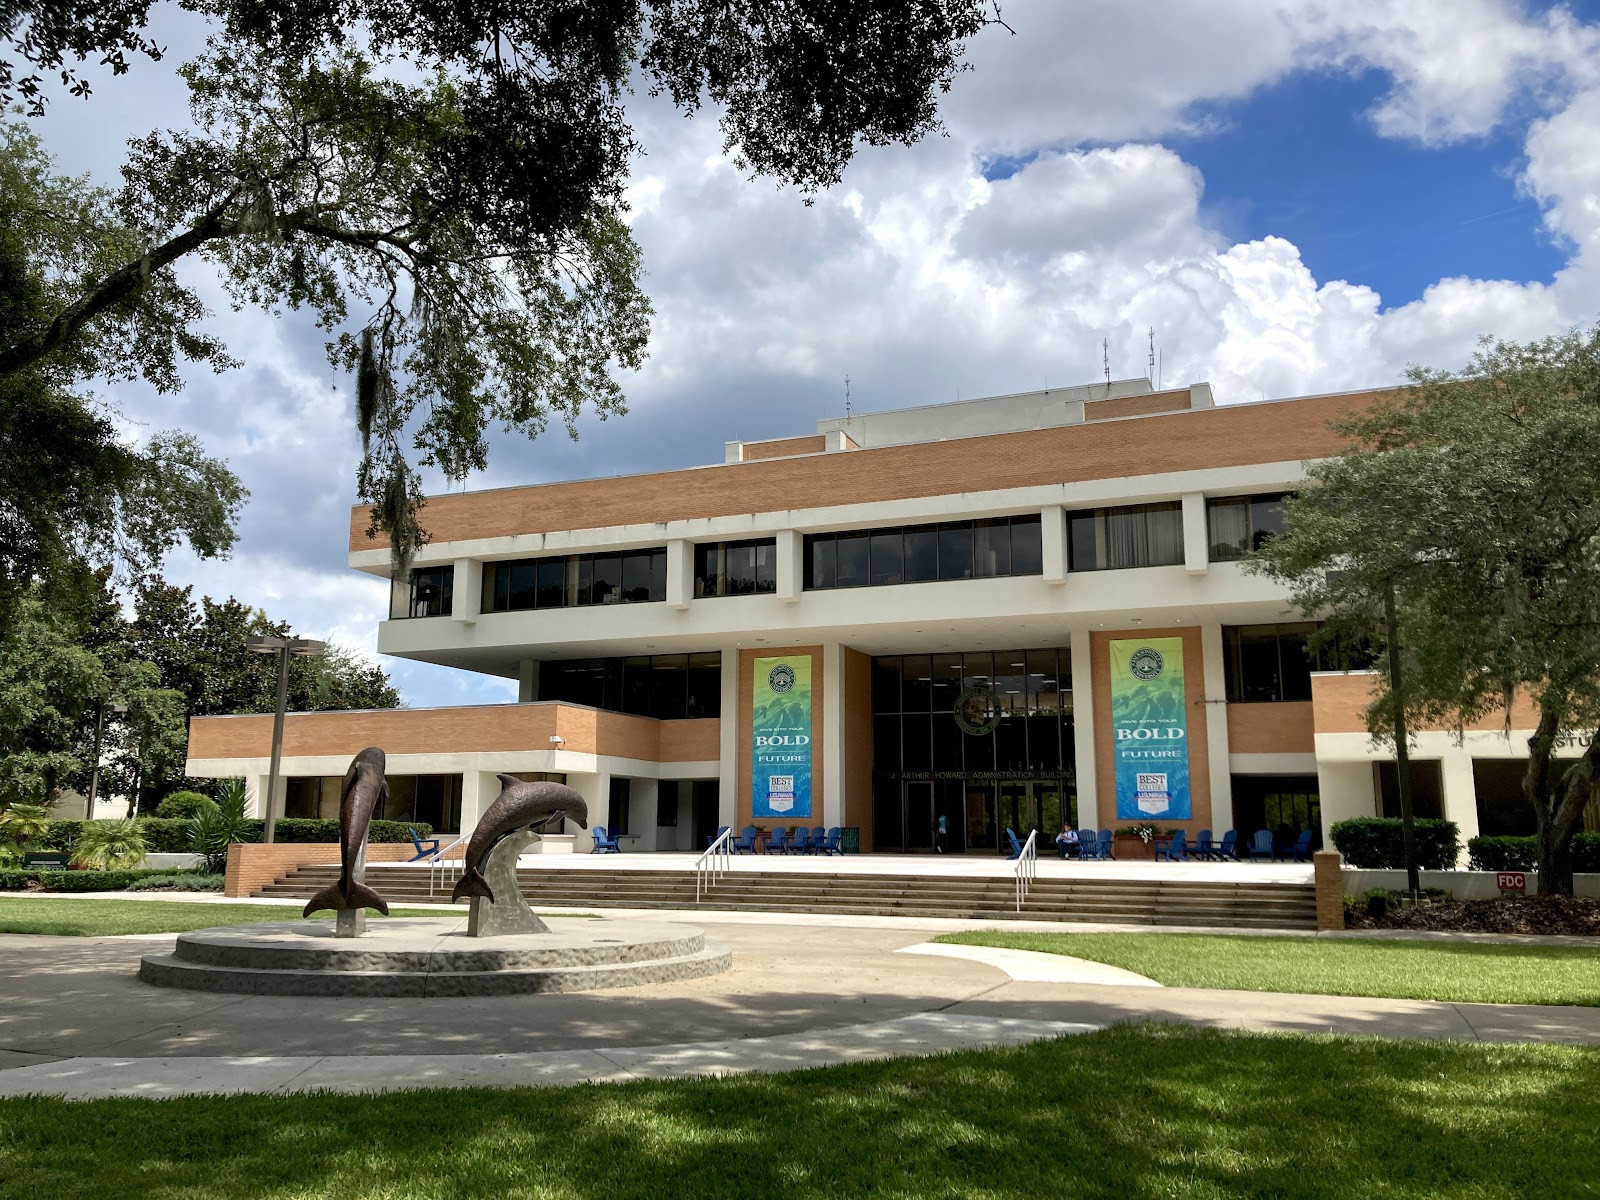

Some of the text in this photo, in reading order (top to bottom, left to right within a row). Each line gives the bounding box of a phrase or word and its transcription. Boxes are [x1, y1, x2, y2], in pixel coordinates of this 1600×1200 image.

[1116, 727, 1185, 740] BOLD
[755, 734, 810, 746] BOLD
[1121, 750, 1182, 758] FUTURE
[972, 771, 1035, 779] ADMINISTRATION
[1040, 771, 1075, 779] BUILDING
[1138, 775, 1166, 784] BEST
[771, 777, 792, 786] BEST
[1498, 875, 1524, 888] FDC
